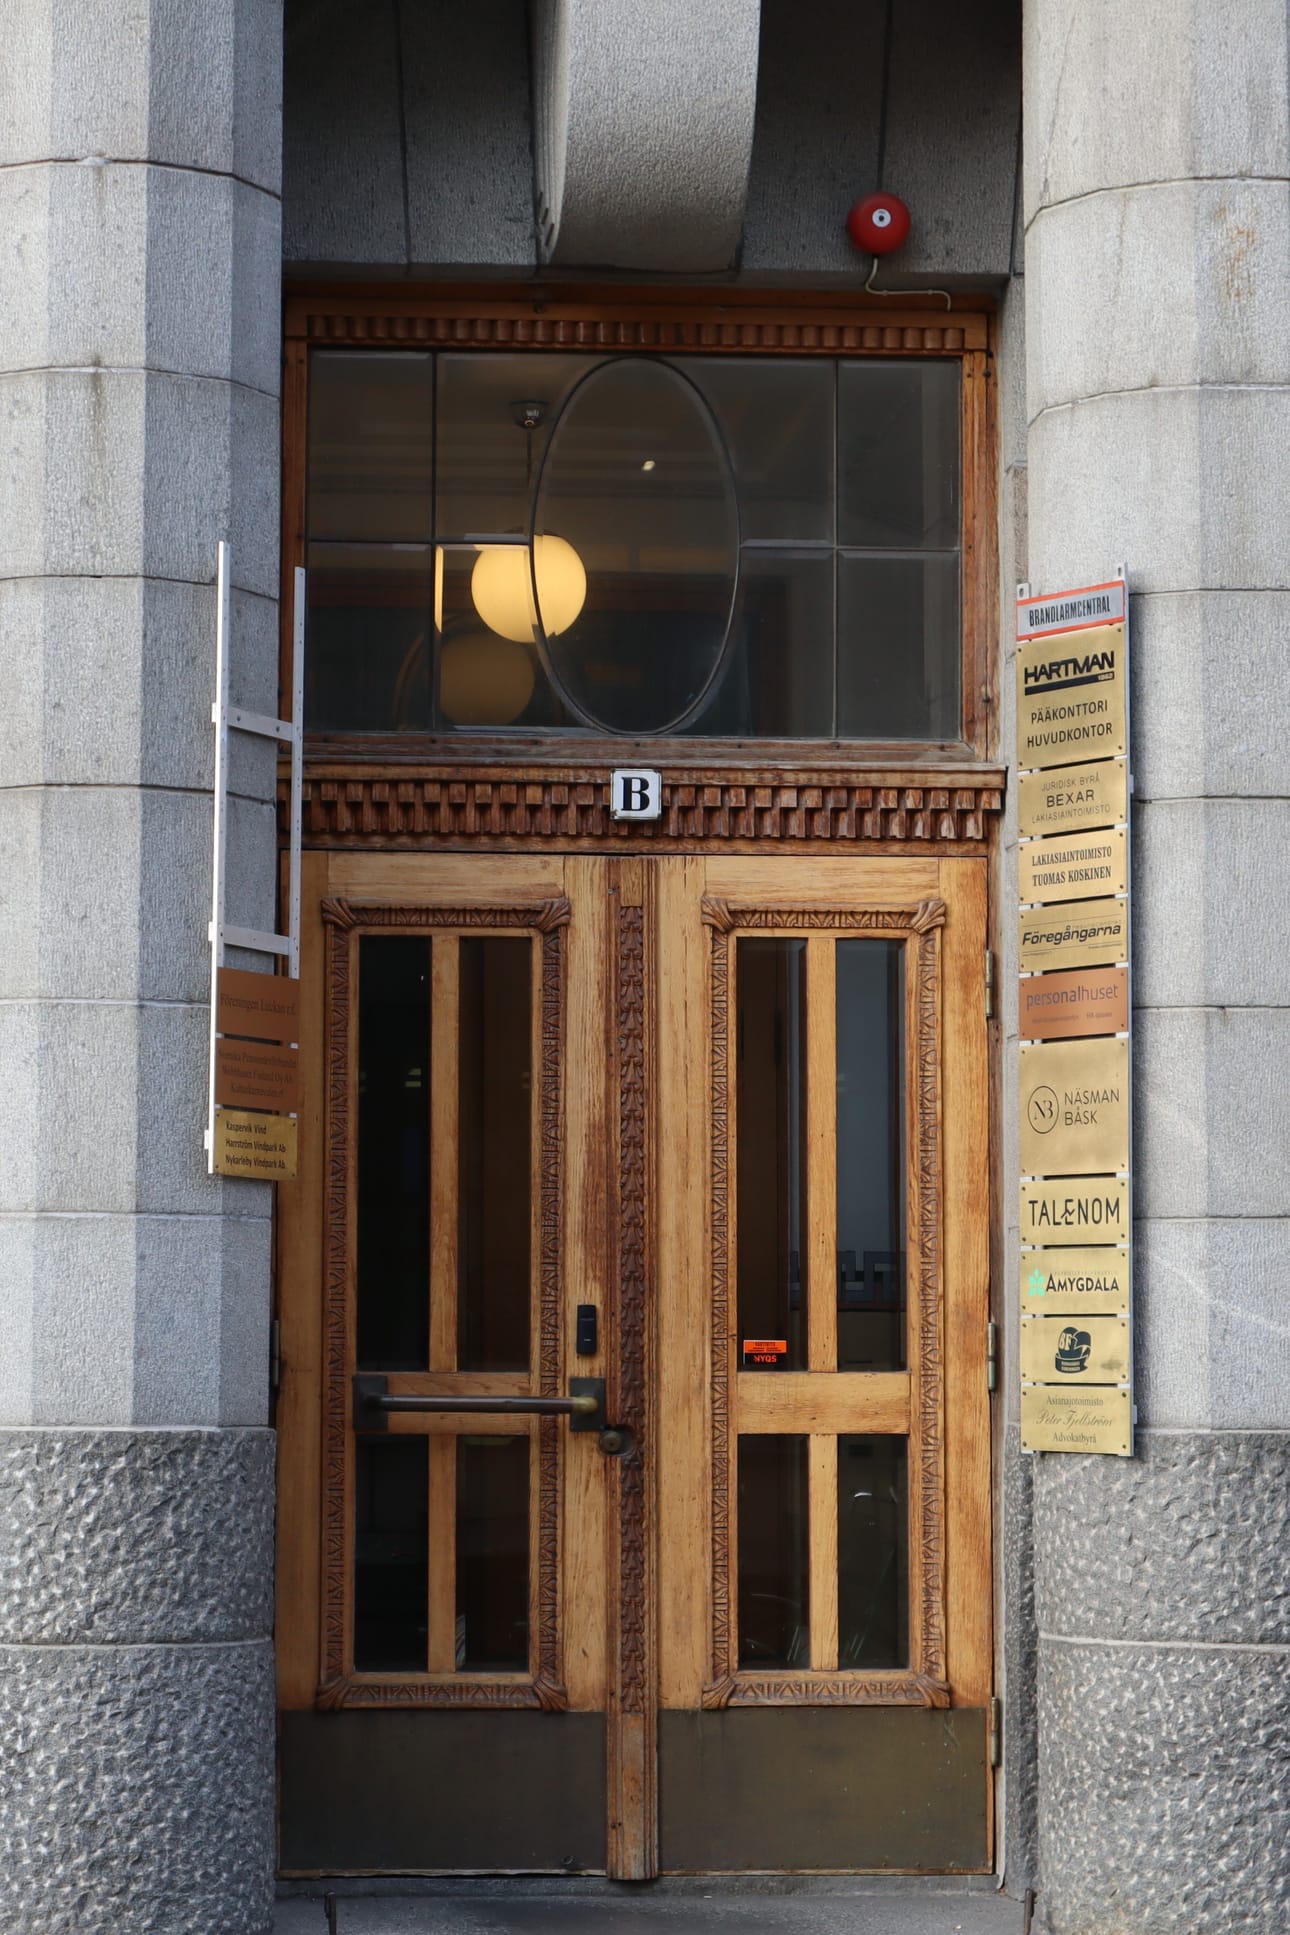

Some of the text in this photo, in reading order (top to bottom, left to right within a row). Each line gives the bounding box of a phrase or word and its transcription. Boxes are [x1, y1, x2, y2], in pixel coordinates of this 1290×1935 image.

[1029, 595, 1110, 627] BRANDLARMCENTRAL
[1024, 651, 1115, 684] HARTMAN
[1031, 699, 1108, 724] PÄÄKONTTORI
[1027, 722, 1113, 748] HUVUDKONTOR
[621, 776, 650, 811] B
[1042, 777, 1076, 792] JURIDISK
[1046, 789, 1095, 808] BEXAR
[1032, 804, 1111, 824] LAKIASIAINTOIMISTO
[1032, 846, 1112, 866] LAKIASIAINTOIMISTO
[1032, 866, 1112, 887] TUOMAS KOSKINEN
[1022, 924, 1121, 945] Föregångarna
[1026, 984, 1119, 1011] personalhuset
[1064, 1088, 1120, 1105] NÄSMAN
[1064, 1106, 1098, 1126] BÅSK
[1028, 1197, 1121, 1227] TALENOM
[1046, 1273, 1119, 1292] AMYGDALA
